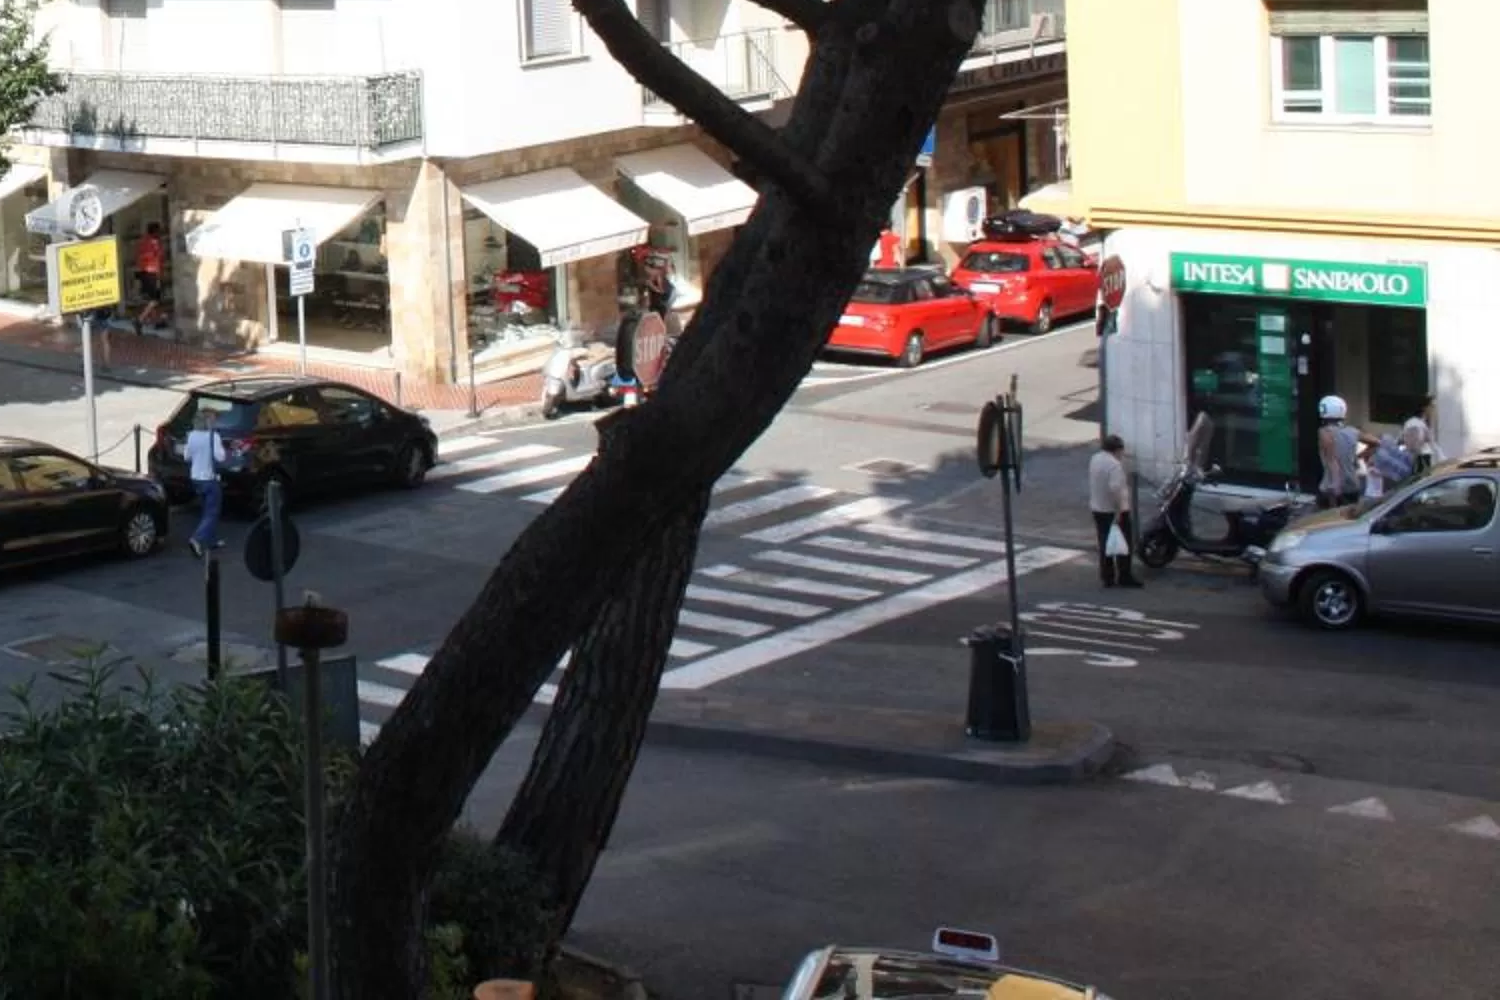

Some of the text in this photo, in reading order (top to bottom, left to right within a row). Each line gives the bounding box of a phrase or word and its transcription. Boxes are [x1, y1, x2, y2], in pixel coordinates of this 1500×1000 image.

[1103, 269, 1124, 296] STOP
[1183, 261, 1409, 296] INTESA SANPAOLO
